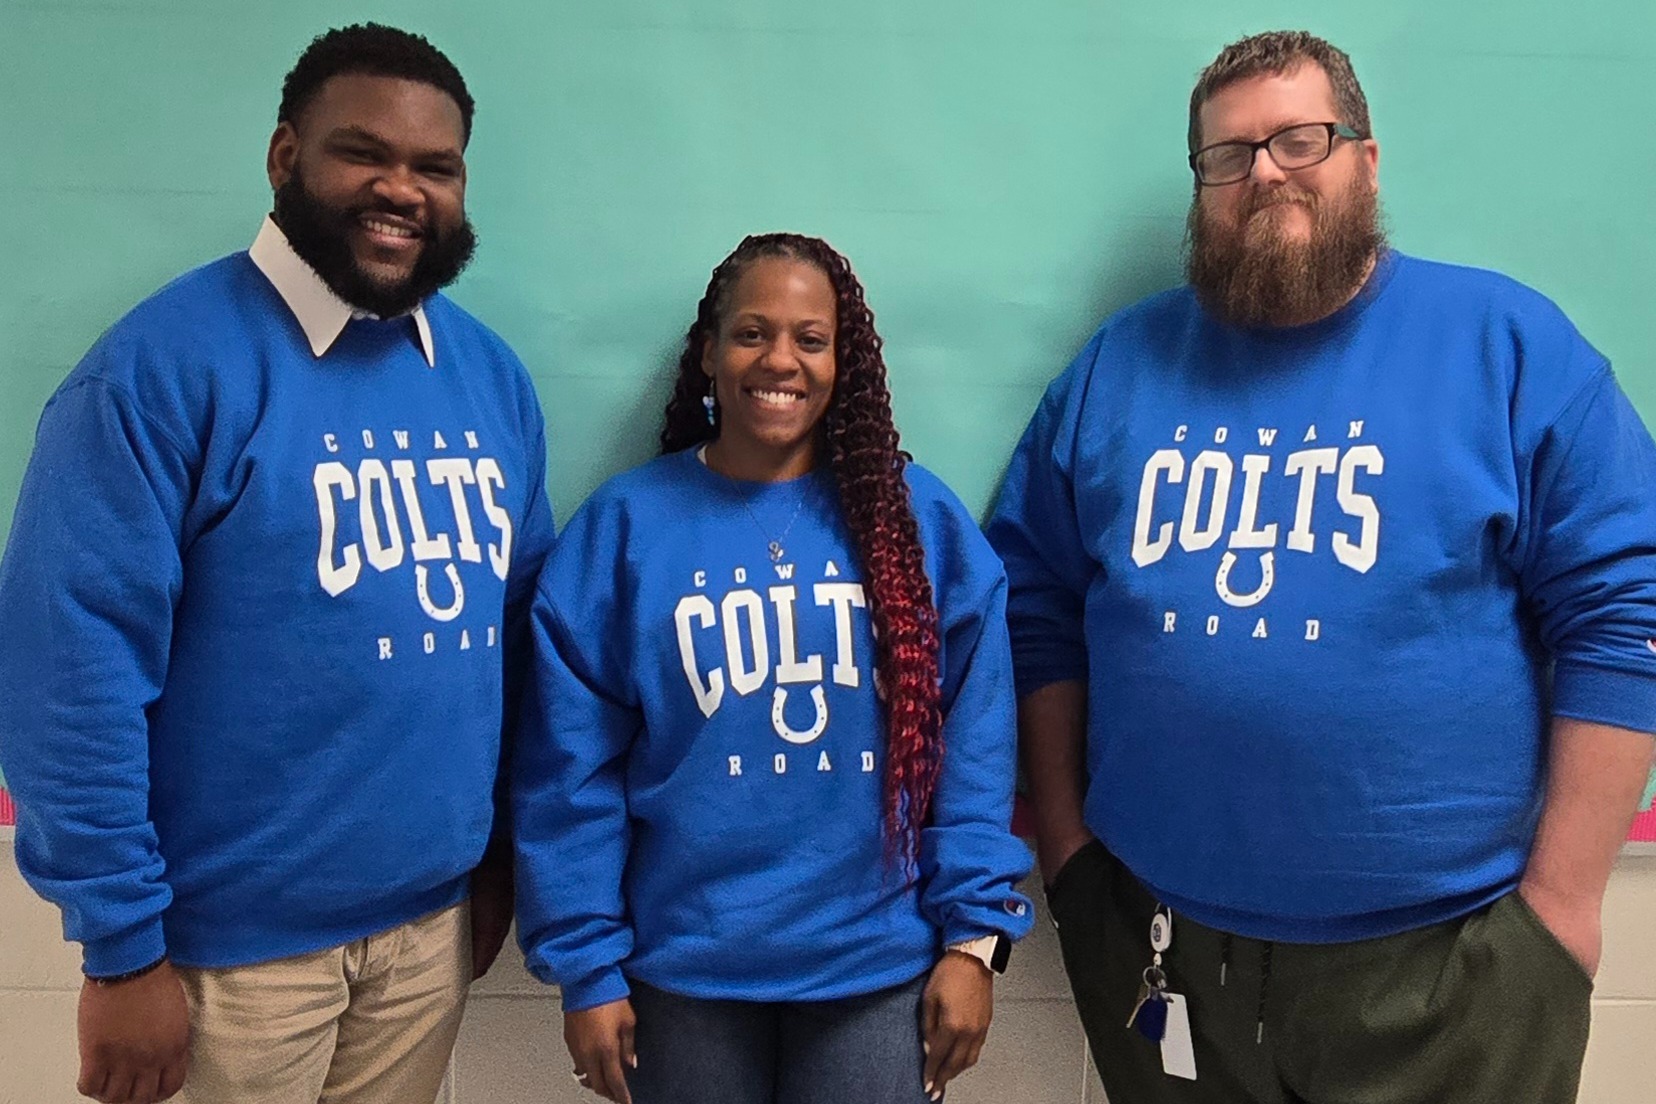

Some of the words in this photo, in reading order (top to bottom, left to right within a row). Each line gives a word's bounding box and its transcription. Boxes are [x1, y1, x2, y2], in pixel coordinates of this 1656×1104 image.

[324, 429, 479, 453] COWAN
[1174, 420, 1364, 447] COWAN
[1131, 444, 1385, 574] COLTS
[313, 457, 512, 598] COLTS
[694, 560, 839, 588] COWA
[1163, 611, 1320, 641] ROAD
[674, 582, 888, 719] COLT
[728, 750, 874, 776] ROAD
